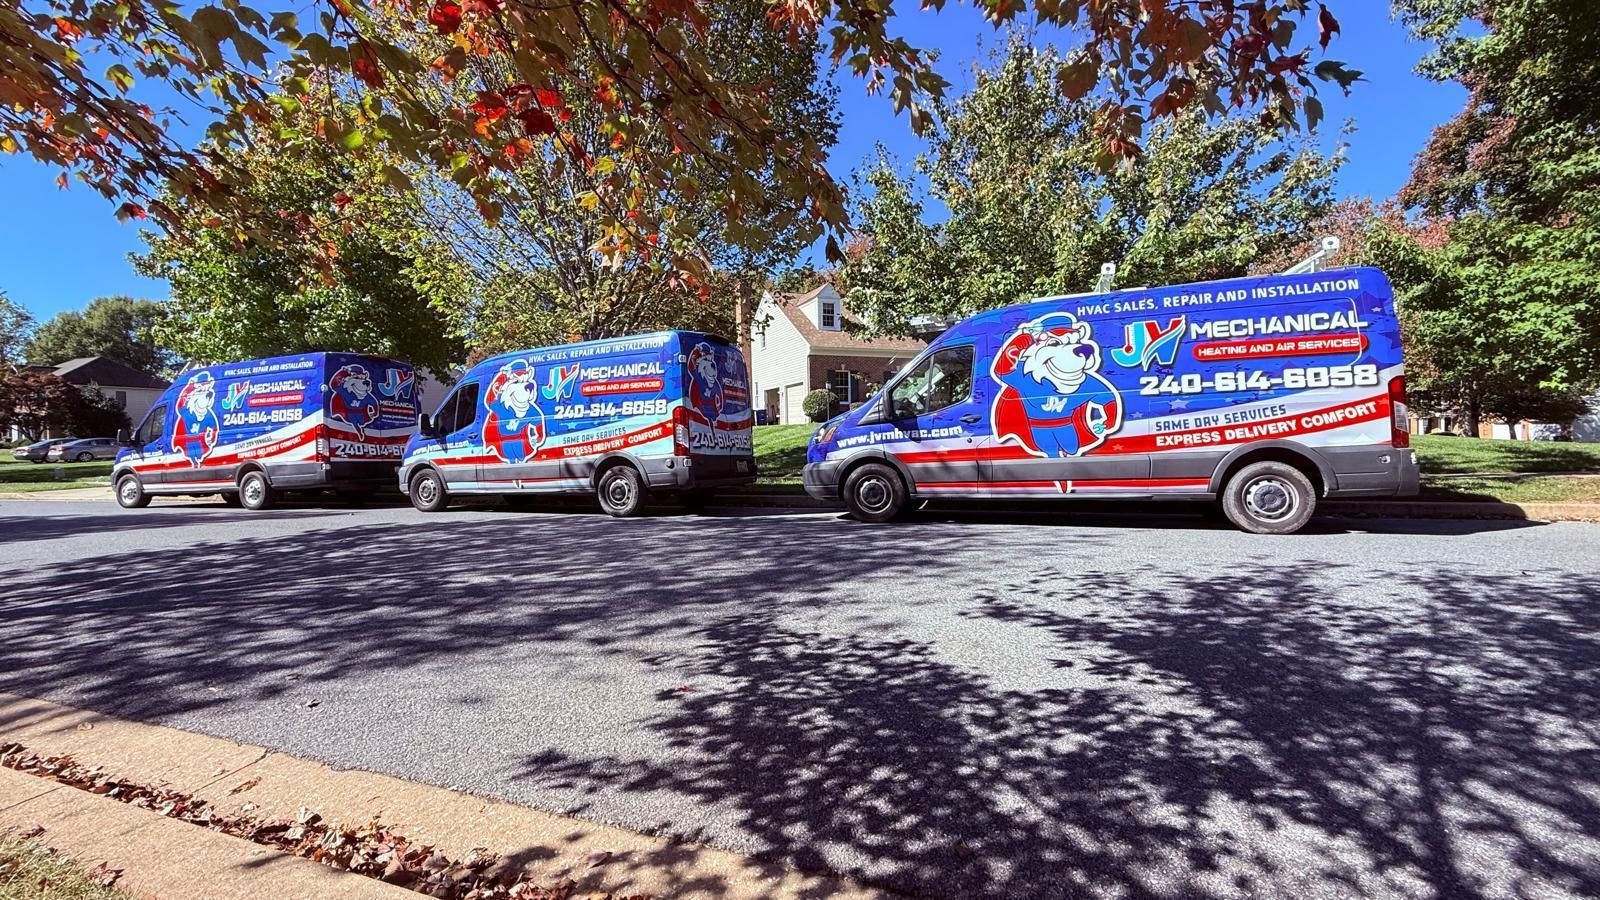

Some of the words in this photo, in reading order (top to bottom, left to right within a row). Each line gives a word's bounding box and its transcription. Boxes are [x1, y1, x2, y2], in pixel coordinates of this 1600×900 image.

[1077, 304, 1111, 316] HVAC
[1114, 299, 1159, 313] SALES,
[1163, 292, 1212, 308] REPAIR
[1216, 290, 1247, 302] AND
[1252, 279, 1359, 299] INSTALLATION
[529, 355, 546, 364] HVAC
[570, 349, 594, 358] REPAIR
[595, 346, 611, 355] AND
[612, 340, 664, 353] INSTALLATION
[1111, 314, 1186, 371] JV
[1190, 310, 1369, 339] MECHANICAL
[1198, 344, 1247, 357] HEATING
[1249, 343, 1274, 354] AND
[1275, 341, 1295, 352] AIR
[1298, 337, 1360, 351] SERVICES
[249, 380, 306, 394] MECHANICAL
[378, 368, 415, 401] JV
[541, 362, 580, 402] JV
[580, 361, 665, 381] MECHANICAL
[582, 385, 607, 393] HEATING
[620, 383, 630, 391] AIR
[631, 380, 661, 390] SERVICES
[1140, 364, 1379, 395] 240-614-6058
[223, 408, 303, 426] 240-614-6058
[554, 399, 668, 419] 240-614-6058
[1155, 418, 1190, 431] SAME
[1194, 415, 1219, 428] DAY
[1224, 404, 1287, 424] SERVICES
[1156, 431, 1221, 446] EXPRESS
[1224, 420, 1297, 440] DELIVERY
[1301, 401, 1377, 429] COMFORT
[562, 436, 580, 445] SAME
[581, 433, 594, 442] DAY
[596, 427, 627, 439] SERVICES
[563, 444, 592, 456] EXPRESS
[593, 438, 625, 452] DELIVERY
[628, 427, 663, 444] COMFORT
[836, 425, 963, 448] www.jvmhvac.com
[335, 443, 405, 456] 240-614-60
